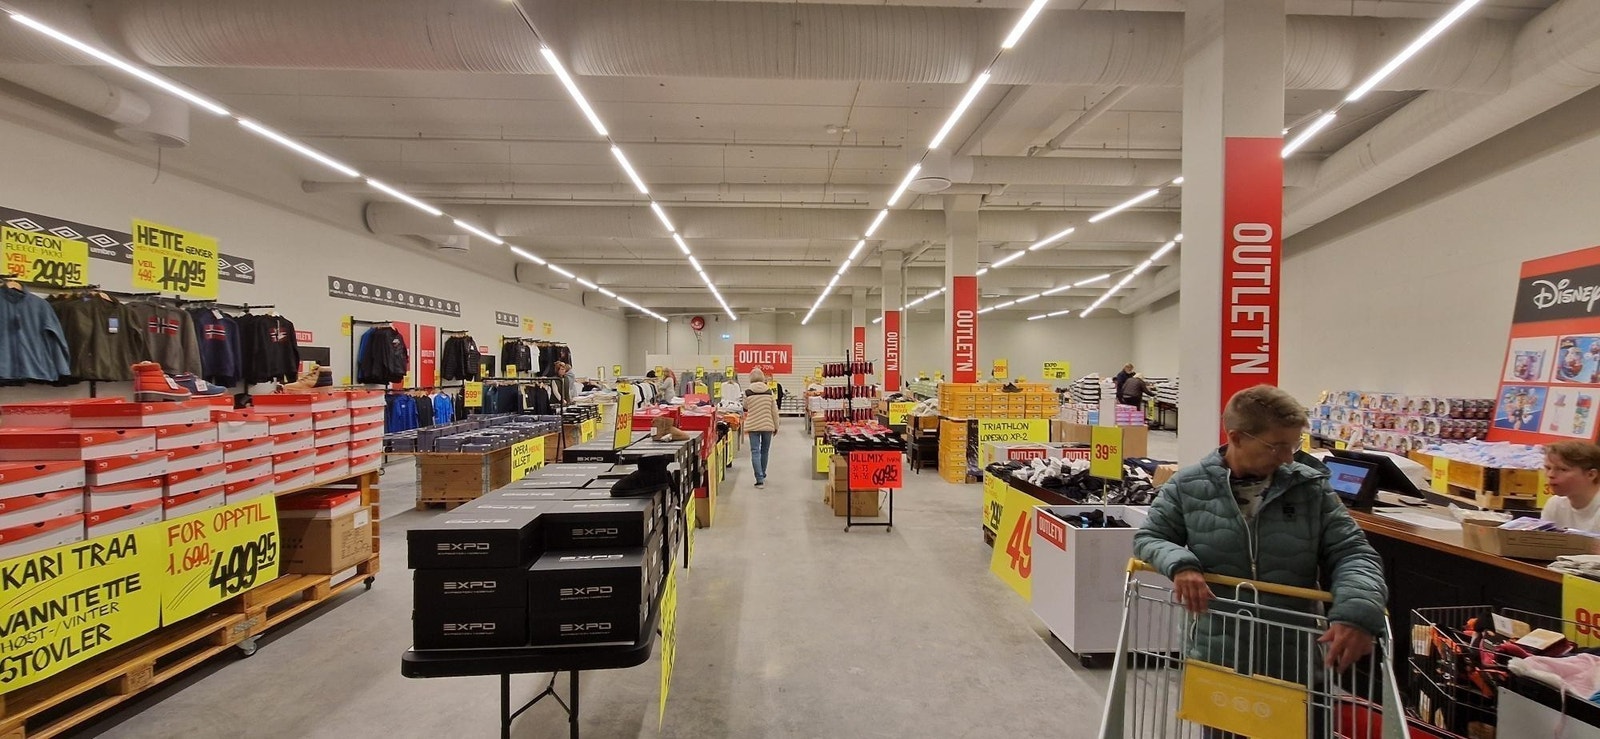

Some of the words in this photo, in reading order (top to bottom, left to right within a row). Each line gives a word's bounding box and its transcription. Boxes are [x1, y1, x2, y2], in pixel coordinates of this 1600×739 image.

[6, 231, 61, 251] MOVEON
[90, 246, 116, 256] umbro
[137, 225, 184, 252] HETTE
[185, 246, 213, 259] GENSER
[6, 253, 32, 263] VEIL
[137, 260, 155, 268] VEIL
[1230, 223, 1273, 374] OUTLET'N
[855, 342, 864, 363] OUTLE
[887, 332, 898, 371] OUTLET'N
[956, 310, 973, 372] OUTLET'N
[739, 350, 787, 364] OUTLET'N
[982, 422, 1029, 430] TRIATHLON
[851, 453, 883, 462] ULLMIX
[213, 503, 270, 532] OPPTIL
[1039, 516, 1063, 544] OUTLET'N
[2, 552, 62, 591] KARI
[71, 534, 137, 570] TRAA
[0, 573, 141, 638] VANNTETTE
